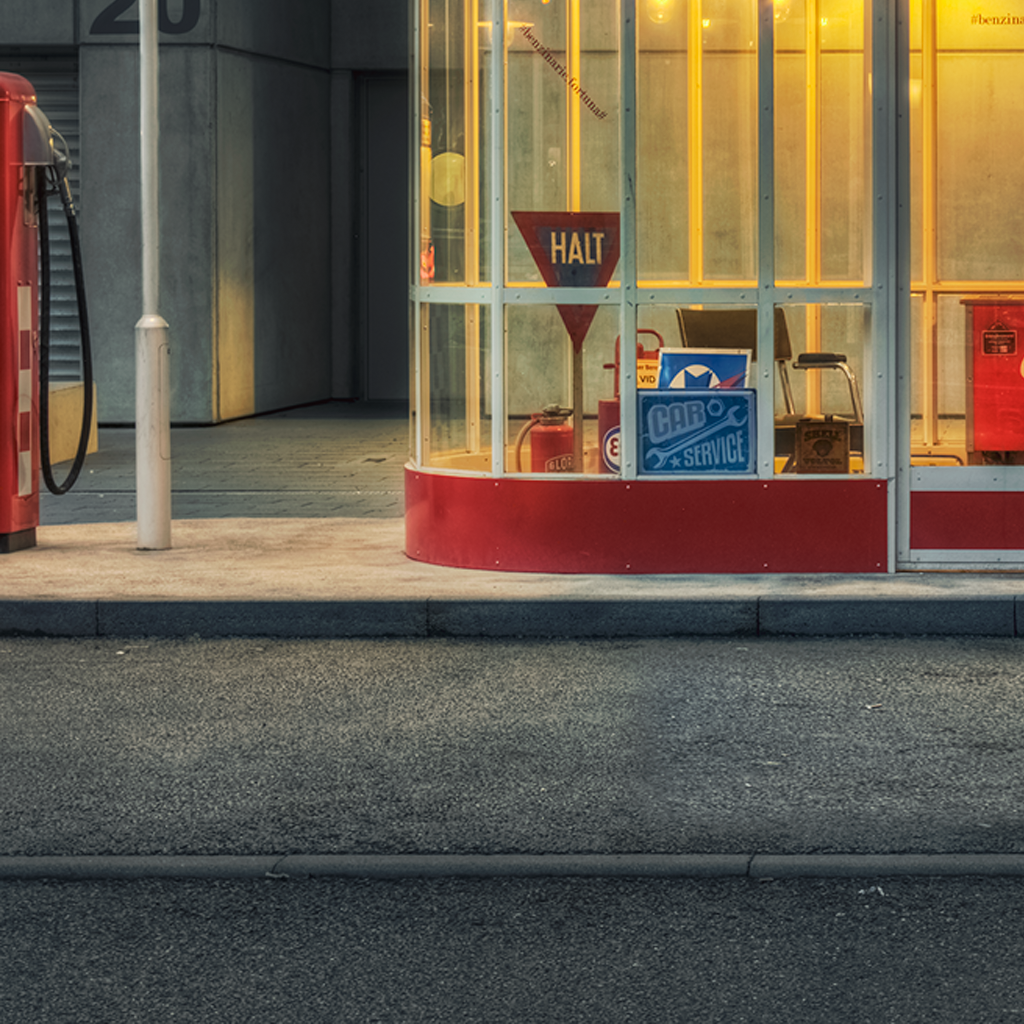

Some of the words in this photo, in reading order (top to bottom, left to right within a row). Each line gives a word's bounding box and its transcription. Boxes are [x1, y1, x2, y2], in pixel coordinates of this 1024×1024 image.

[551, 231, 605, 265] HALT
[650, 400, 706, 443] CAR
[683, 430, 745, 467] SERVICE
